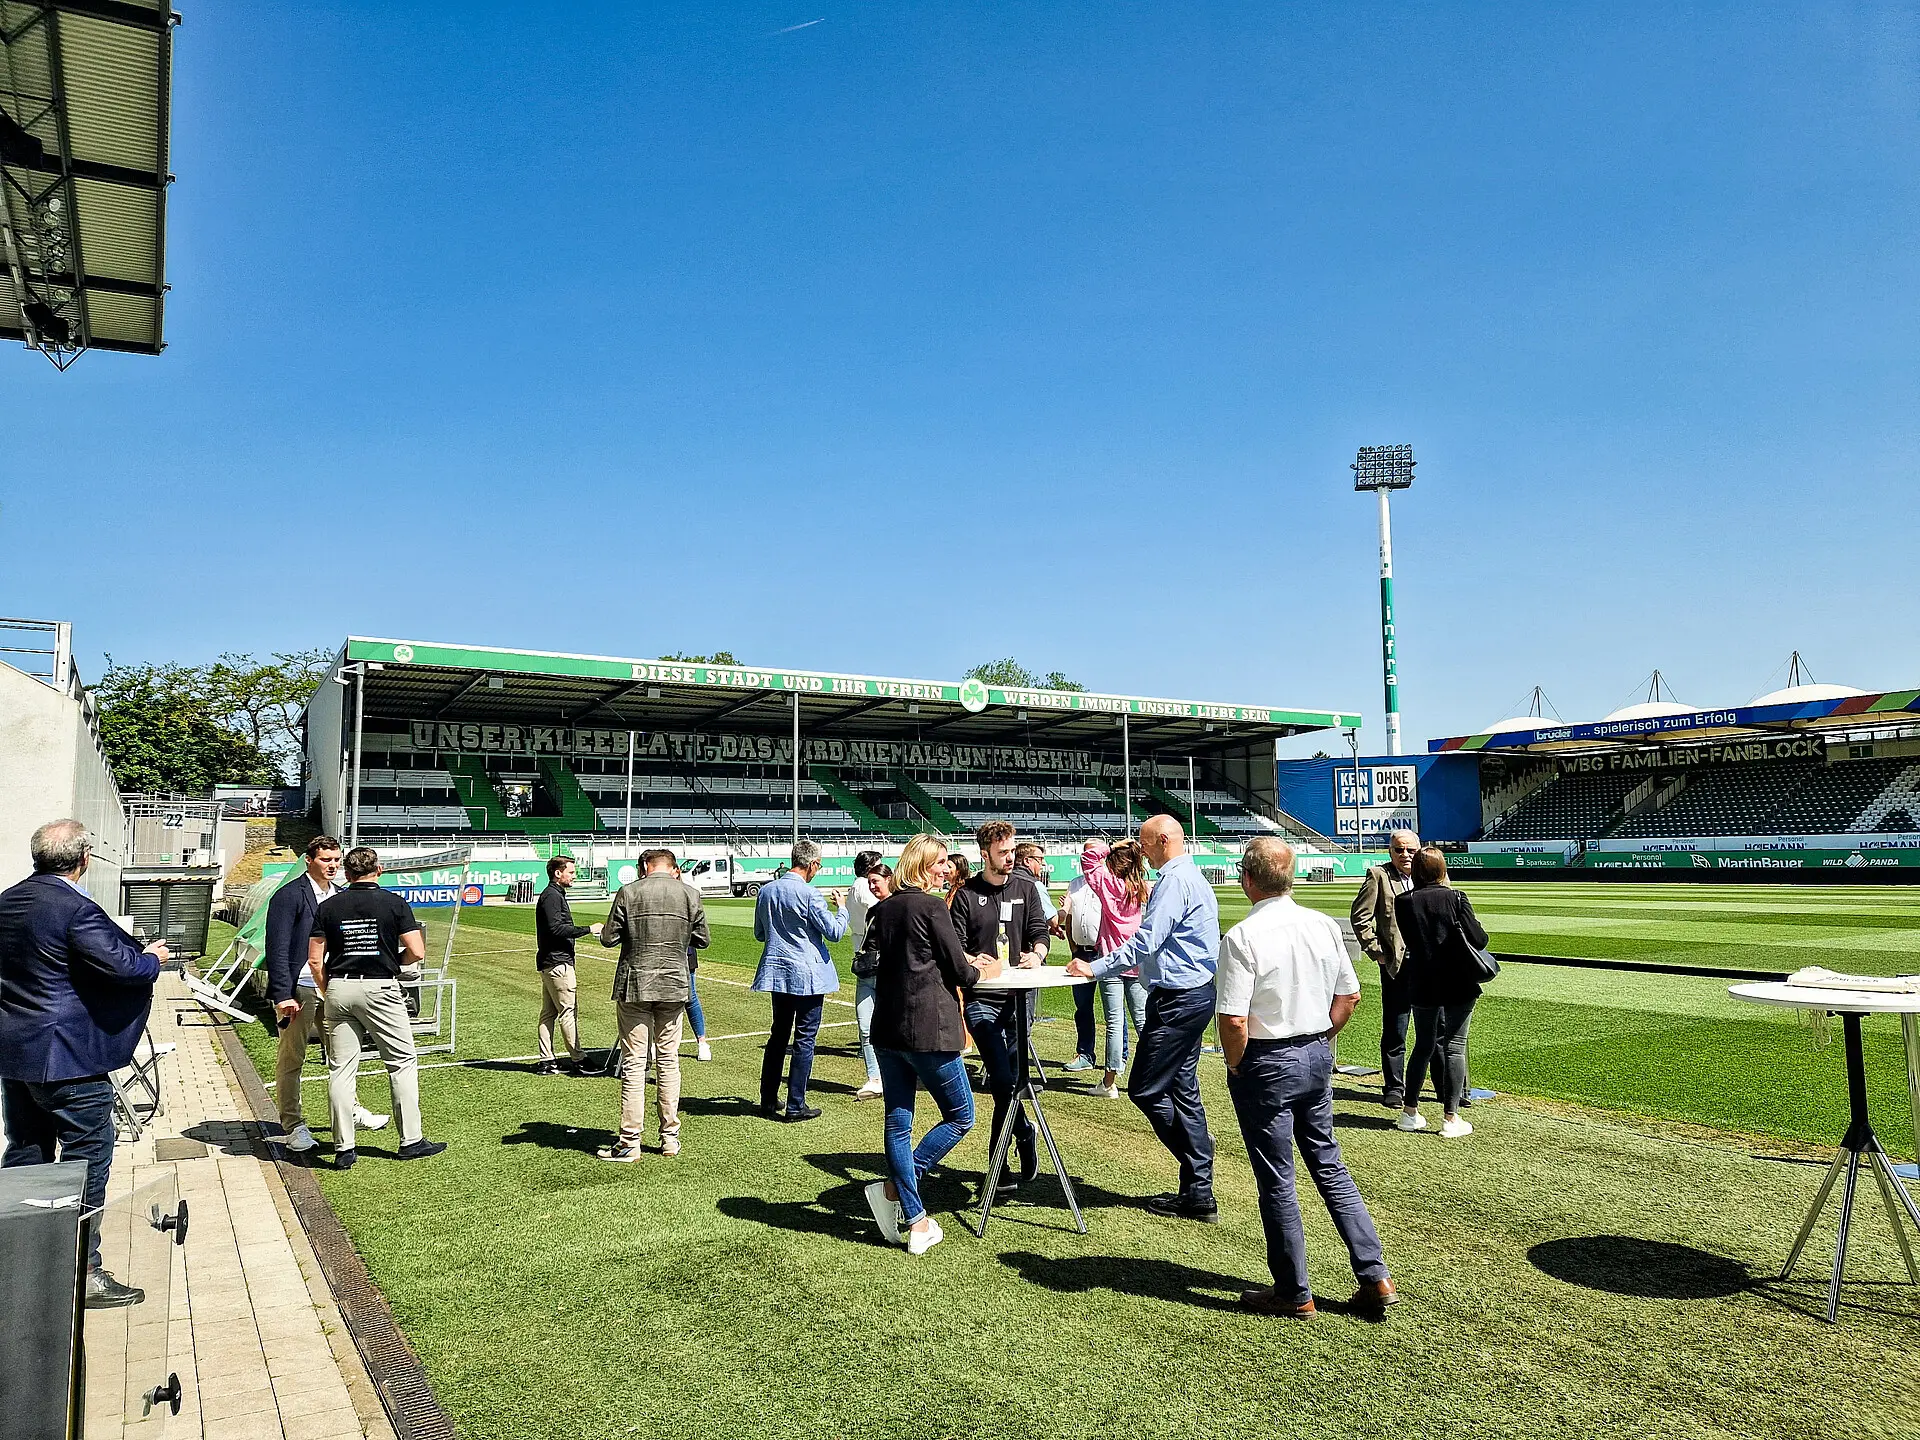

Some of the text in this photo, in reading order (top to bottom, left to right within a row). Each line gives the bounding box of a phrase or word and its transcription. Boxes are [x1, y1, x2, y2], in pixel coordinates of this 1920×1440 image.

[1384, 605, 1397, 685] infra
[632, 664, 943, 700] DIESE STADT UND IHR VEREIN
[1003, 692, 1271, 722] WERDEN IMMER UNSERE LIEBE SEIN
[1536, 729, 1572, 740] bruder
[1593, 720, 1660, 736] spielerisch
[1664, 718, 1691, 729] zum
[1695, 712, 1736, 725] Erfolg
[413, 723, 521, 750] UNSER
[722, 735, 773, 759] DAS
[779, 739, 844, 761] WIRD
[850, 743, 951, 765] NIEMALS
[1561, 739, 1822, 774] WBG FAMILIEN-FANBLOCK
[1340, 772, 1369, 787] KEN
[1376, 771, 1409, 785] OHNE
[1341, 786, 1369, 803] FAN
[1377, 786, 1414, 803] JOB.
[166, 813, 183, 827] 22
[1526, 859, 1557, 867] Sparkasse
[1718, 857, 1803, 867] MartinBauer
